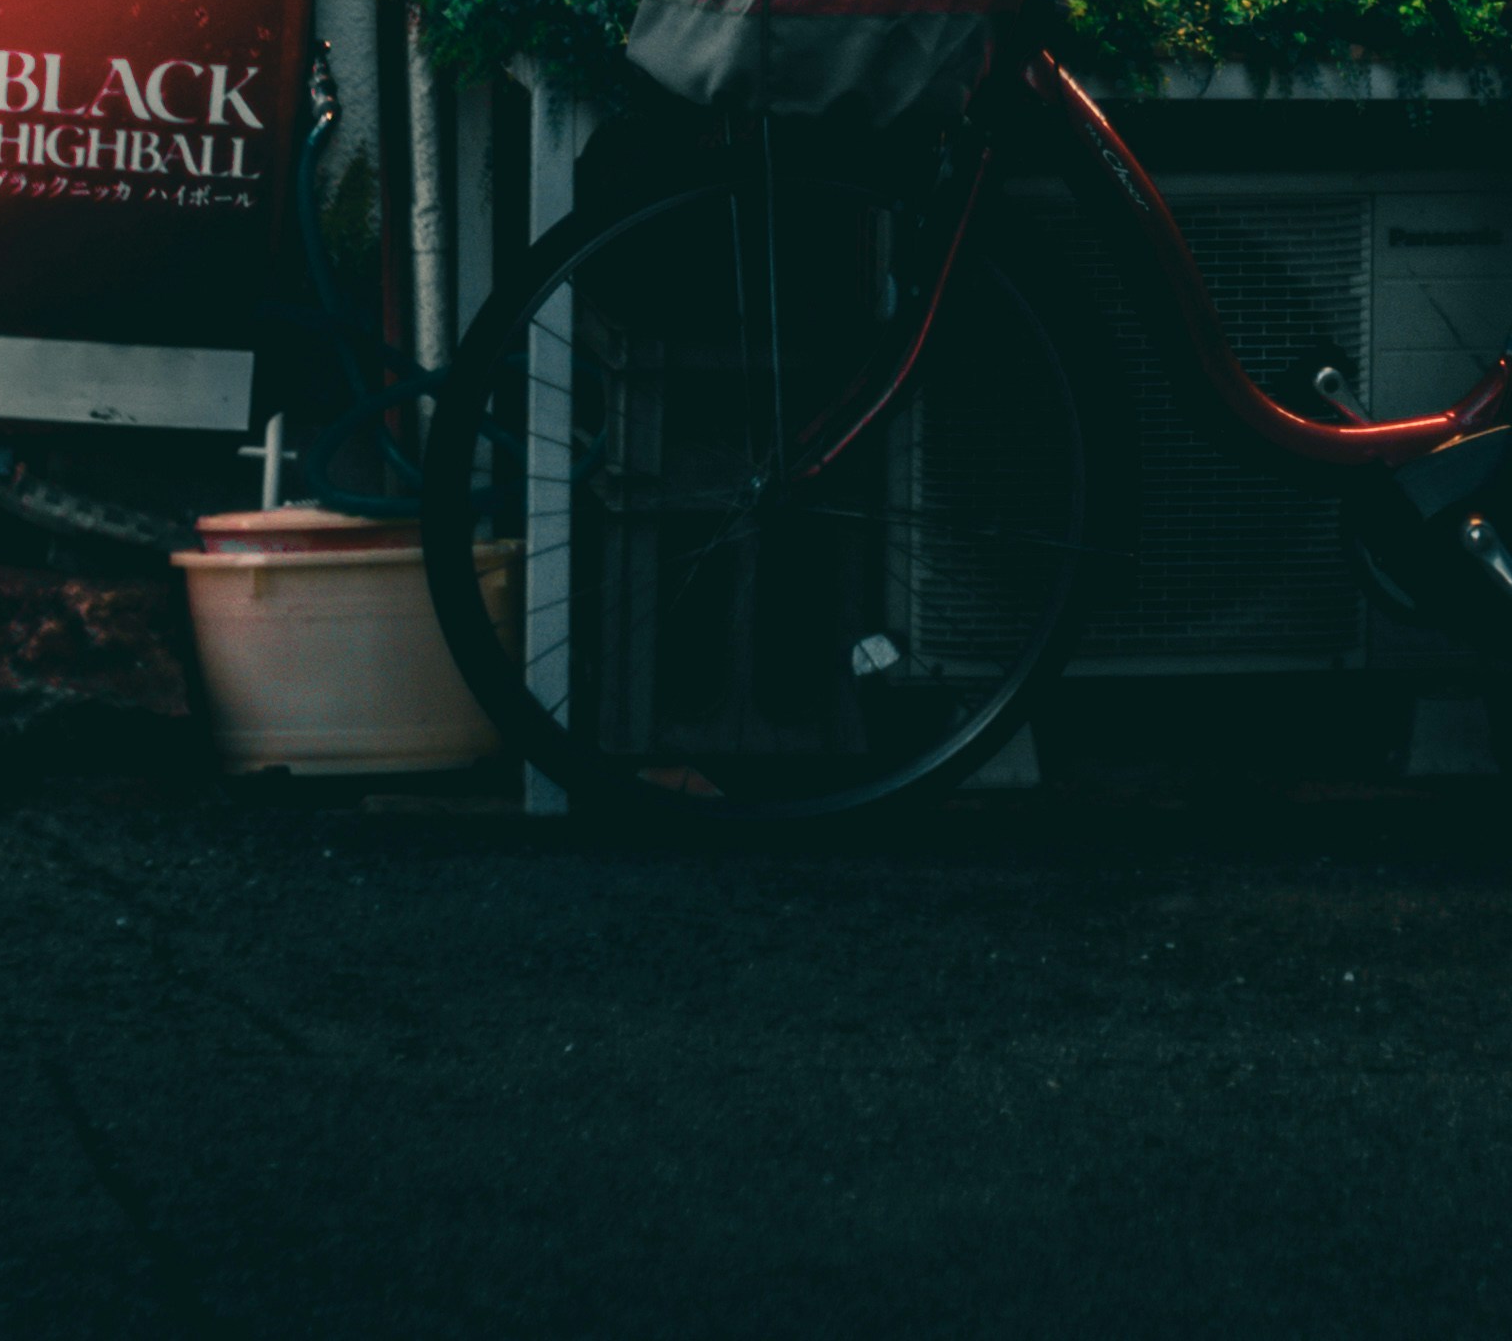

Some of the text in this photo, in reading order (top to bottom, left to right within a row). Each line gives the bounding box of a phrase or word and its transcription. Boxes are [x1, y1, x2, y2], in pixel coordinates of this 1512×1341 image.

[146, 183, 257, 209] ハイボール
